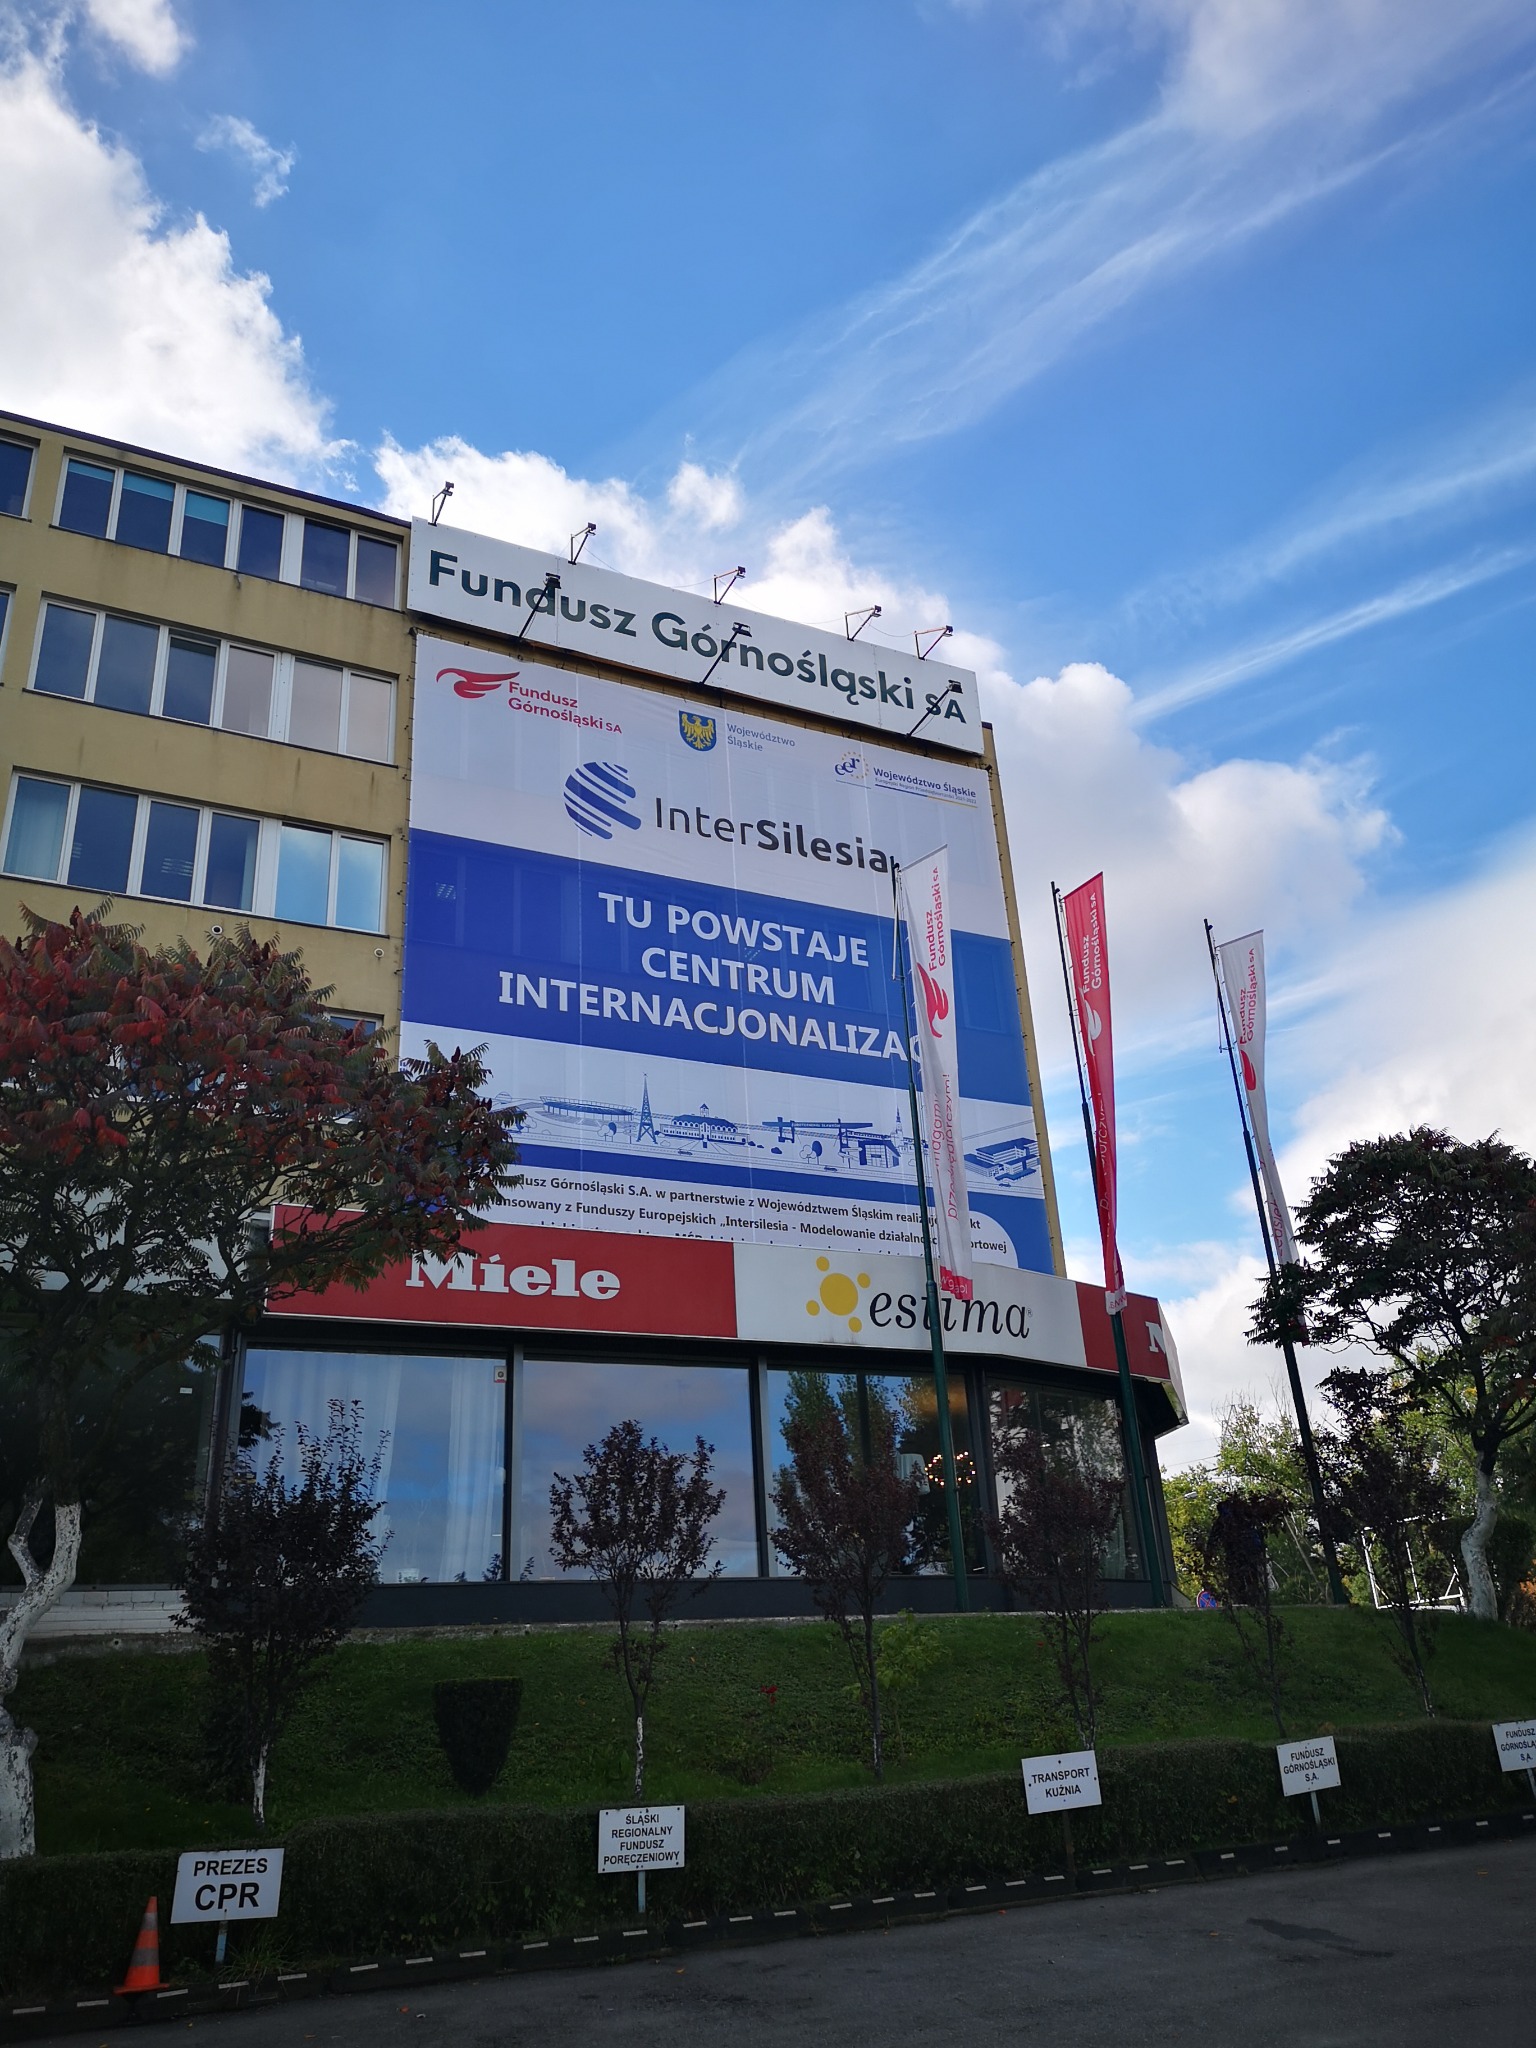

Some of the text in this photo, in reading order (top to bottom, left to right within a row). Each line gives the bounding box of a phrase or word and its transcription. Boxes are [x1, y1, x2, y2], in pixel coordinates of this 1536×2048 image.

[429, 550, 636, 638] Fundusz
[652, 611, 914, 710] Górnośląski
[509, 682, 578, 708] Fundusz
[508, 697, 622, 734] Górnośląski SA
[727, 723, 795, 747] Województwo
[727, 735, 763, 752] Śląskie
[873, 767, 977, 799] Województwo Śląskie
[655, 797, 889, 874] InterSilesia
[599, 892, 869, 968] TU POWSTAJE
[926, 910, 937, 971] Fundusz
[1090, 909, 1101, 989] Górnośląski
[642, 947, 834, 1005] CENTRUM
[1082, 935, 1090, 993] Fundusz
[551, 1177, 624, 1195] Górnośląski
[628, 1185, 652, 1198] S.A.
[655, 1191, 666, 1199] w
[670, 1190, 746, 1207] partnerstwie
[749, 1199, 755, 1207] z
[757, 1197, 849, 1217] Województwem
[851, 1205, 893, 1221] Śląskim
[565, 1204, 572, 1212] z
[576, 1202, 635, 1219] Funduszy
[639, 1209, 716, 1225] Europejskich
[800, 1222, 876, 1240] Modelowanie
[405, 1248, 620, 1300] Miele
[1501, 1740, 1536, 1752] GÓRNOŚLĄ
[1505, 1728, 1535, 1739] FUNDUSZ
[1283, 1757, 1336, 1775] GÓRNOŚLĄSKI
[1291, 1747, 1325, 1762] FUNDUSZ
[1032, 1768, 1090, 1784] TRANSPORT
[1305, 1772, 1320, 1783] S.A.
[1045, 1783, 1082, 1798] KUŹNIA
[611, 1825, 673, 1839] REGIONALNY
[625, 1813, 660, 1826] ŚLĄSKI
[603, 1850, 680, 1866] PORĘCZENIOWY
[619, 1839, 665, 1852] FUNDUSZ
[193, 1858, 268, 1877] PREZES
[194, 1882, 260, 1911] CPR
